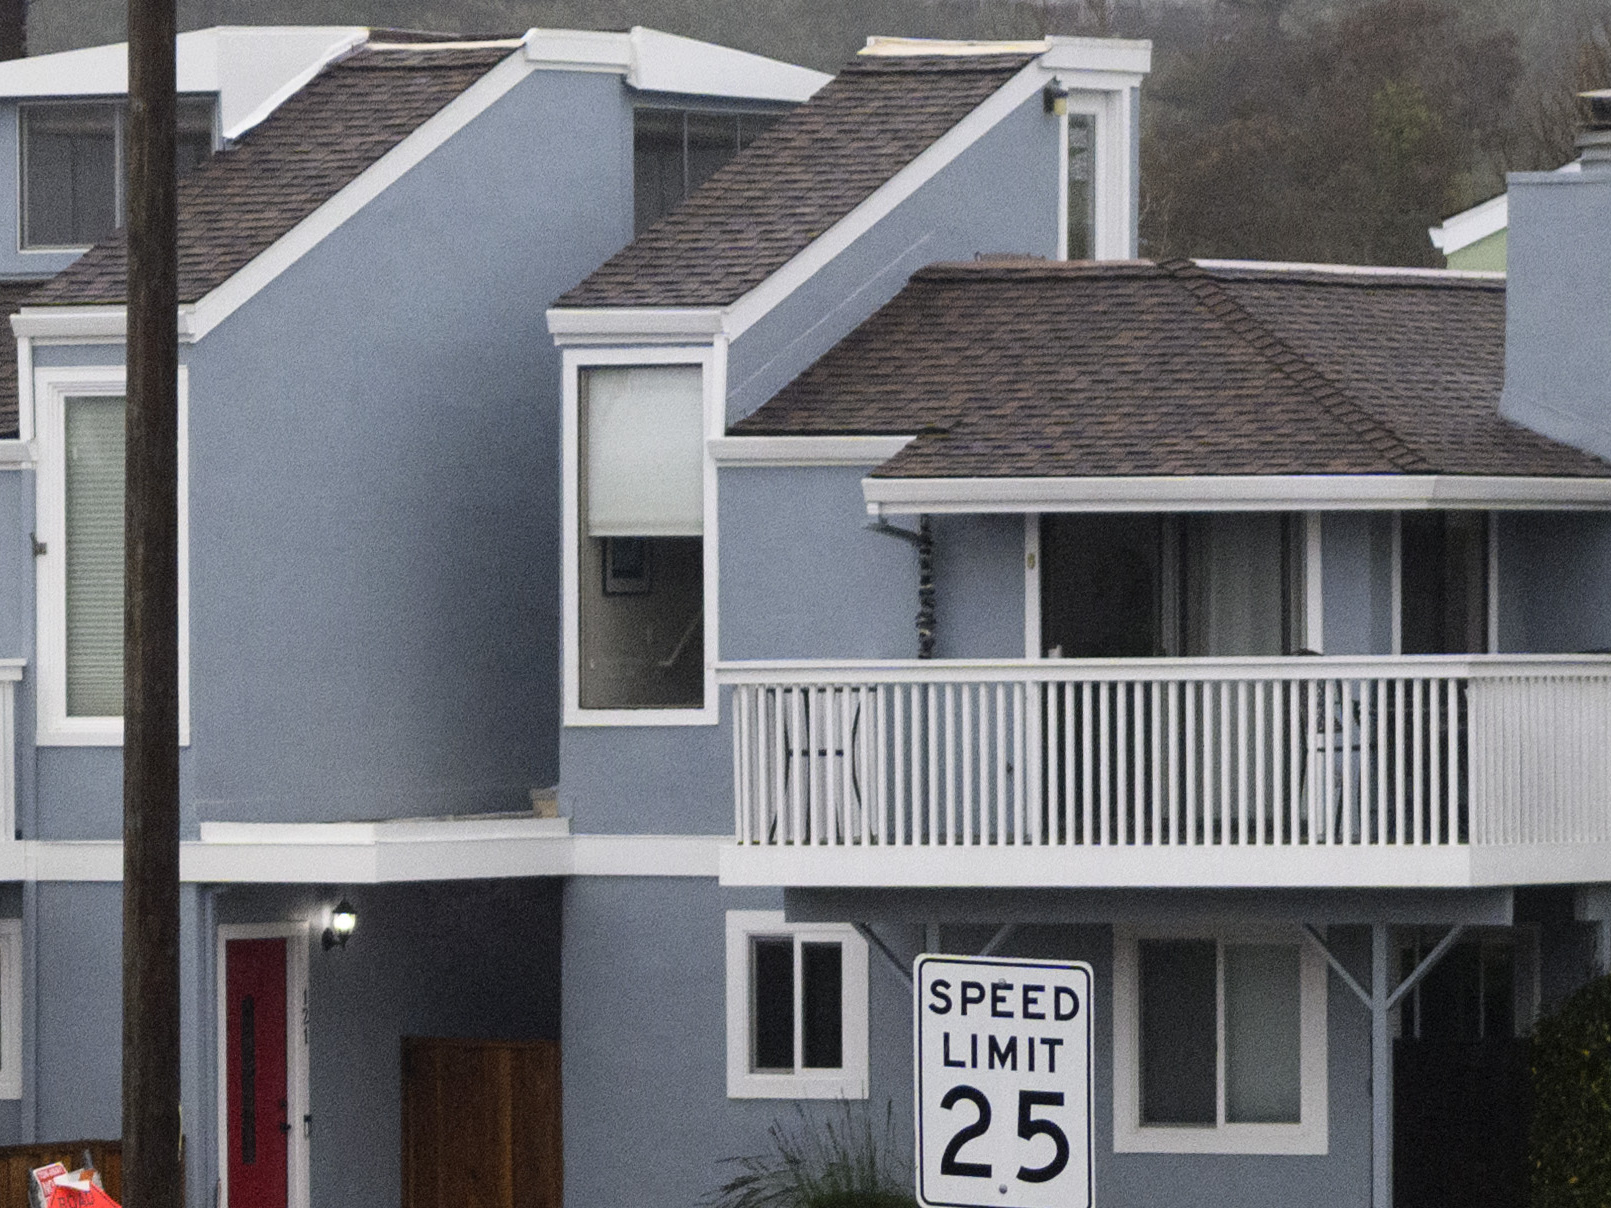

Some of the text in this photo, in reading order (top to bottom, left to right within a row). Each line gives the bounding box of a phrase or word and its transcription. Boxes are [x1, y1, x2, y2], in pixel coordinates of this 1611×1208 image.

[928, 978, 1080, 1022] SPEED
[943, 1031, 1064, 1073] LIMIT
[940, 1084, 1070, 1184] 25
